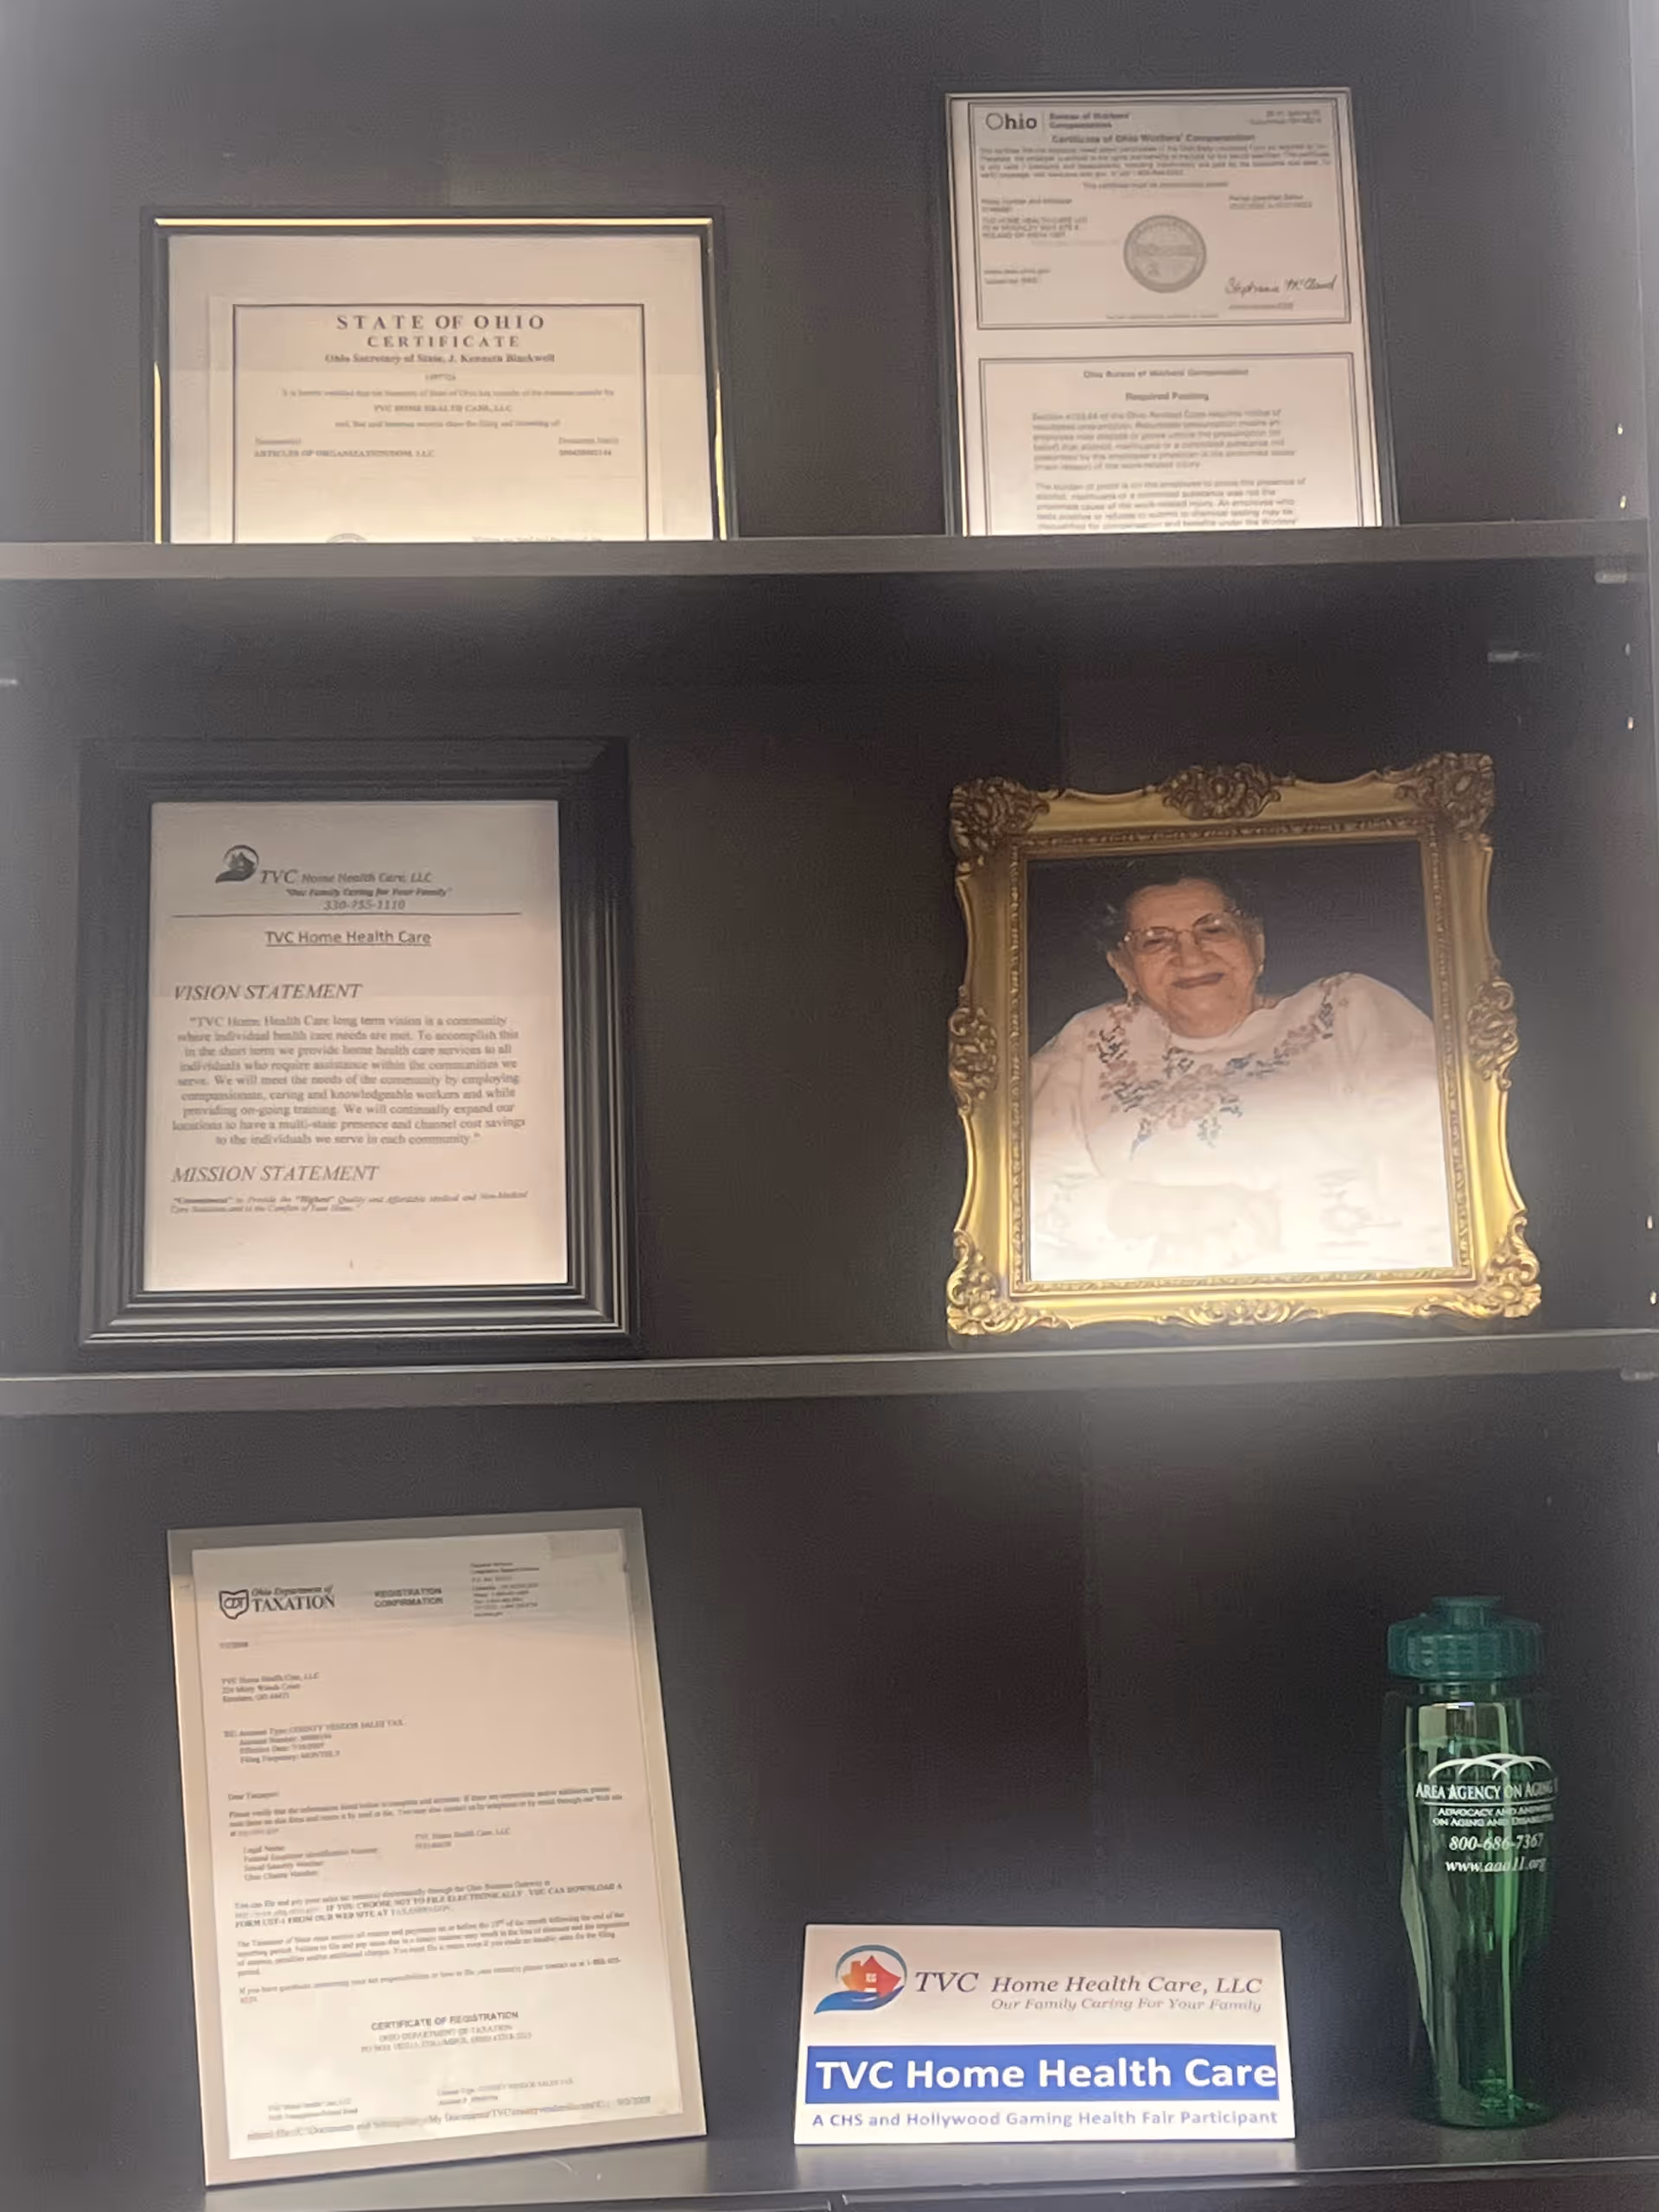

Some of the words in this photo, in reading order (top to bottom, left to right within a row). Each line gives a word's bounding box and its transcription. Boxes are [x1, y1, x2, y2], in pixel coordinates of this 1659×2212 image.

[986, 112, 1038, 130] Ohio
[1103, 134, 1113, 143] of
[336, 315, 424, 330] STATE
[435, 315, 463, 329] OF
[474, 314, 544, 330] OHIO
[366, 334, 519, 347] CERTIFICATE
[260, 868, 299, 884] TVC
[301, 874, 335, 883] Home
[338, 872, 376, 883] Health
[410, 871, 434, 883] LLC
[264, 930, 295, 944] TVC
[298, 930, 342, 944] Home
[346, 929, 394, 944] Health
[398, 930, 432, 944] Care
[174, 984, 240, 1001] VISION
[245, 983, 363, 1001] STATEMENT
[264, 1015, 301, 1026] Health
[304, 1015, 329, 1026] Care
[334, 1015, 358, 1027] long
[273, 1031, 307, 1040] health
[418, 1030, 432, 1040] To
[199, 1047, 215, 1056] the
[297, 1046, 339, 1058] provide
[376, 1046, 410, 1055] health
[499, 1044, 512, 1053] all
[245, 1060, 268, 1070] who
[410, 1060, 425, 1070] the
[214, 1076, 232, 1084] We
[236, 1075, 257, 1084] will
[291, 1076, 308, 1084] the
[346, 1075, 357, 1084] of
[360, 1075, 377, 1084] the
[445, 1075, 457, 1085] by
[462, 1073, 519, 1085] employing
[486, 1088, 515, 1097] while
[240, 1105, 290, 1116] on-going
[343, 1104, 362, 1114] We
[366, 1104, 386, 1114] will
[454, 1103, 493, 1116] expand
[226, 1121, 236, 1129] to
[239, 1120, 266, 1129] have
[460, 1119, 481, 1128] cost
[485, 1116, 525, 1128] savings
[216, 1135, 226, 1145] to
[230, 1135, 246, 1144] the
[251, 1134, 312, 1144] individuals
[367, 1135, 378, 1144] in
[170, 1166, 256, 1185] MISSION
[260, 1165, 381, 1183] STATEMENT
[251, 1586, 272, 1597] Ohio
[322, 1583, 334, 1594] of
[374, 1587, 442, 1599] REGISTRATION
[251, 1594, 336, 1613] TAXATION
[373, 1597, 443, 1609] CONFIRMATION
[1415, 1782, 1446, 1799] AREA
[1448, 1783, 1502, 1800] AGENCY
[1503, 1784, 1522, 1798] ON
[1438, 1808, 1494, 1817] ADVOCACY
[1448, 1832, 1545, 1851] 800-686-7367
[915, 1971, 980, 1993] TVC
[991, 1976, 1058, 1993] Home
[1065, 1974, 1141, 1993] Health
[1147, 1975, 1208, 1996] Care,
[1214, 1977, 1263, 1993] LLC
[991, 1998, 1021, 2010] Our
[1025, 1997, 1077, 2012] Family
[1081, 1997, 1134, 2012] Caring
[1138, 1997, 1164, 2009] For
[1169, 1997, 1205, 2010] Your
[1210, 1998, 1262, 2013] Family
[815, 2060, 894, 2090] TVC
[907, 2059, 1025, 2089] Home
[1039, 2056, 1172, 2088] Health
[1185, 2057, 1276, 2088] Care
[812, 2113, 824, 2126] A
[830, 2113, 863, 2126] CHS
[868, 2113, 900, 2126] and
[906, 2112, 1001, 2129] Hollywood
[1006, 2112, 1072, 2128] Gaming
[1078, 2111, 1136, 2125] Health
[1142, 2111, 1176, 2125] Fair
[1180, 2110, 1278, 2128] Participant
